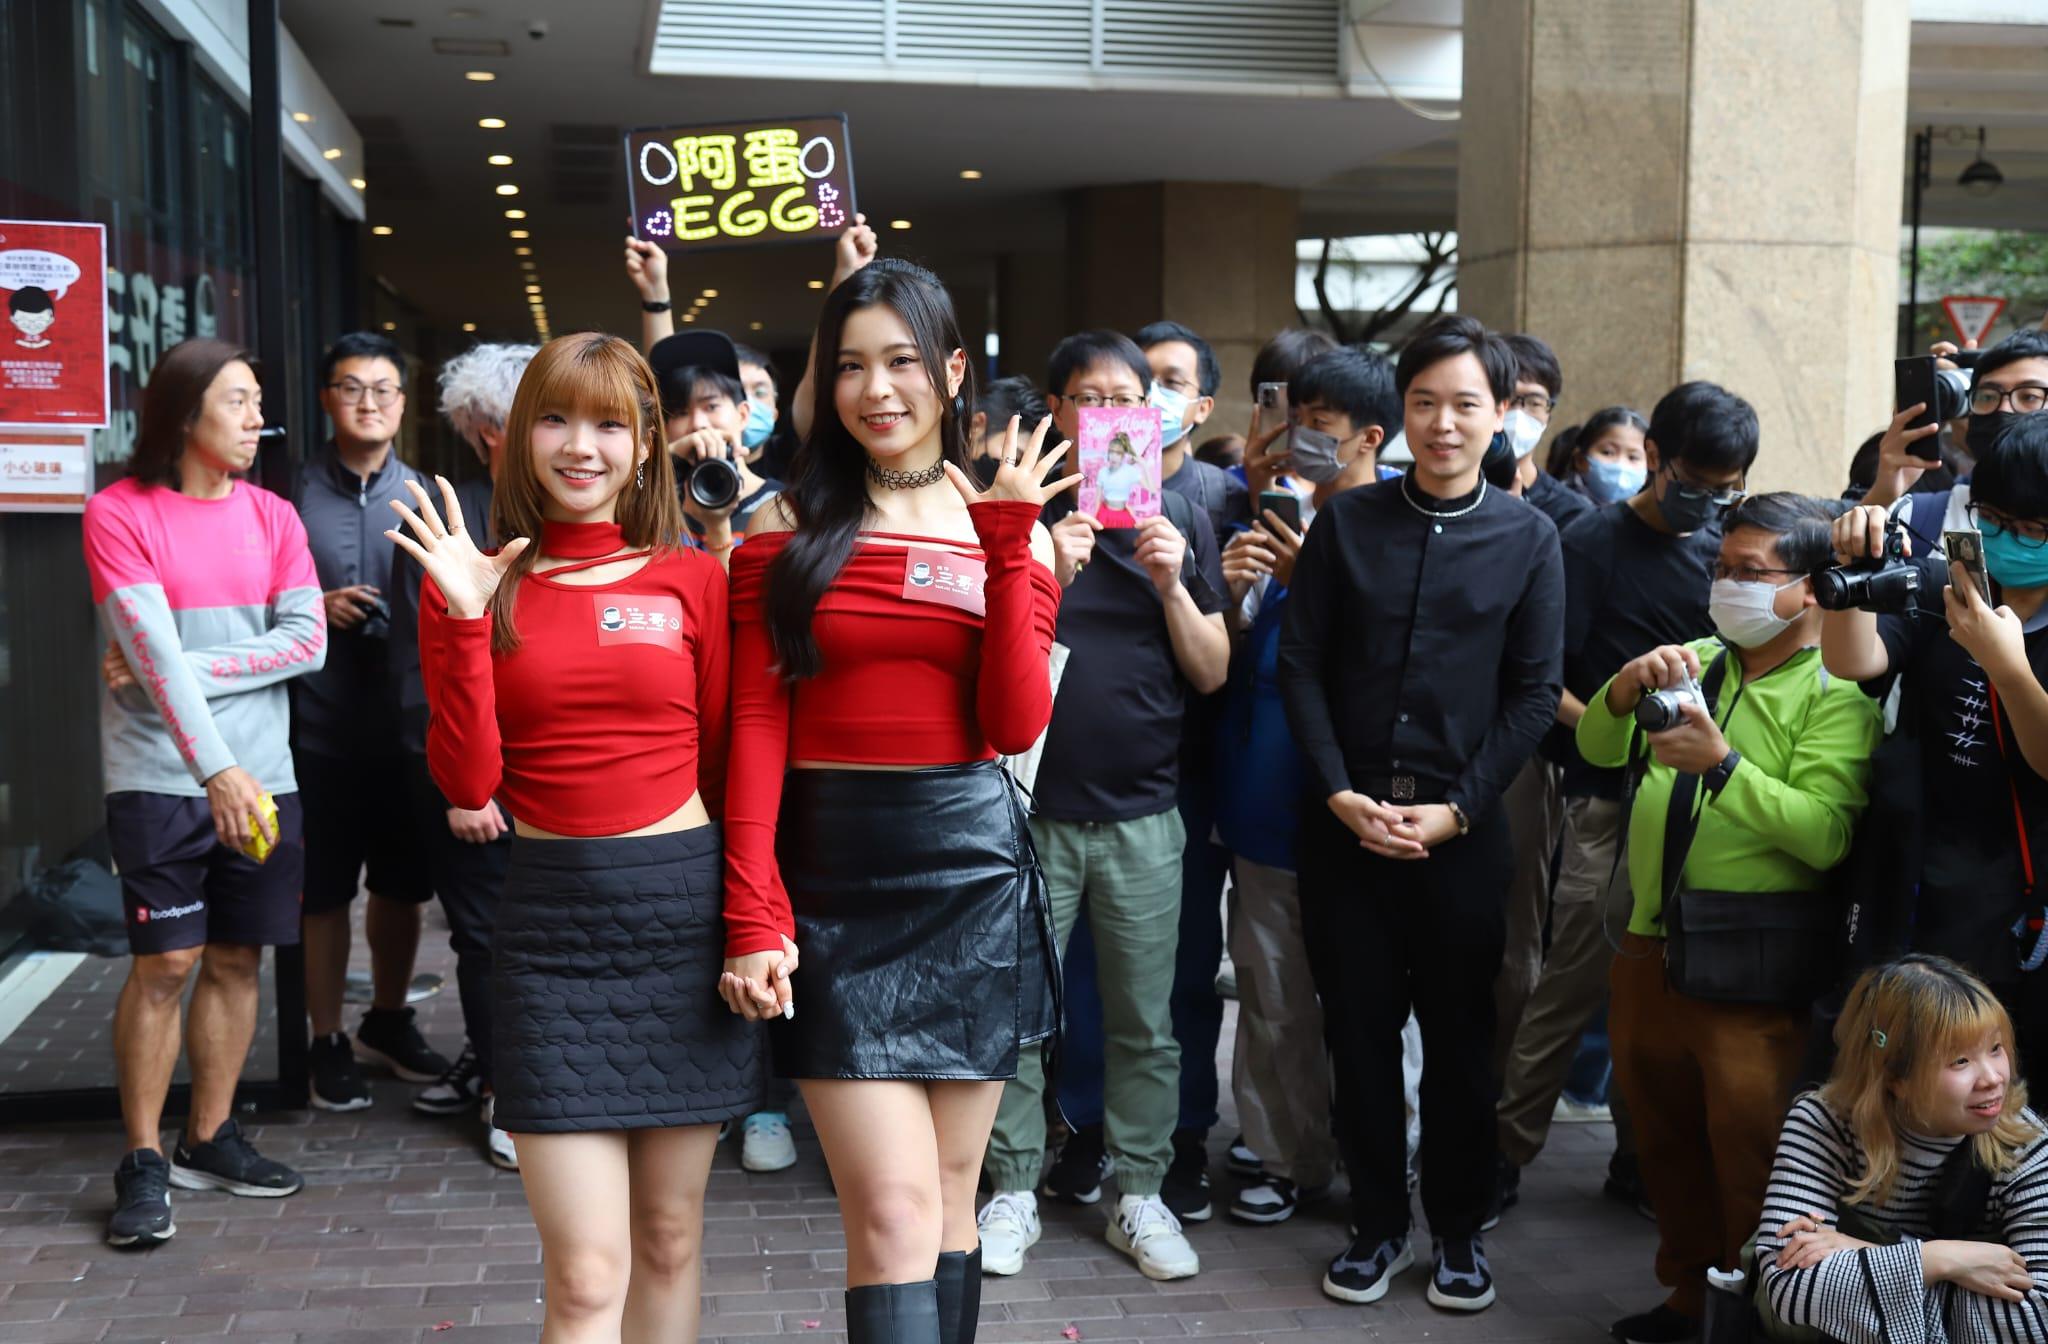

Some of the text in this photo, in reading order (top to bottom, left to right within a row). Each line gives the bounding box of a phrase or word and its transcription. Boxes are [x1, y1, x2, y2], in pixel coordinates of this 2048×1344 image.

[672, 128, 805, 192] 阿蛋
[670, 186, 820, 241] EGG
[935, 571, 973, 591] 三哥
[628, 612, 667, 628] 三哥
